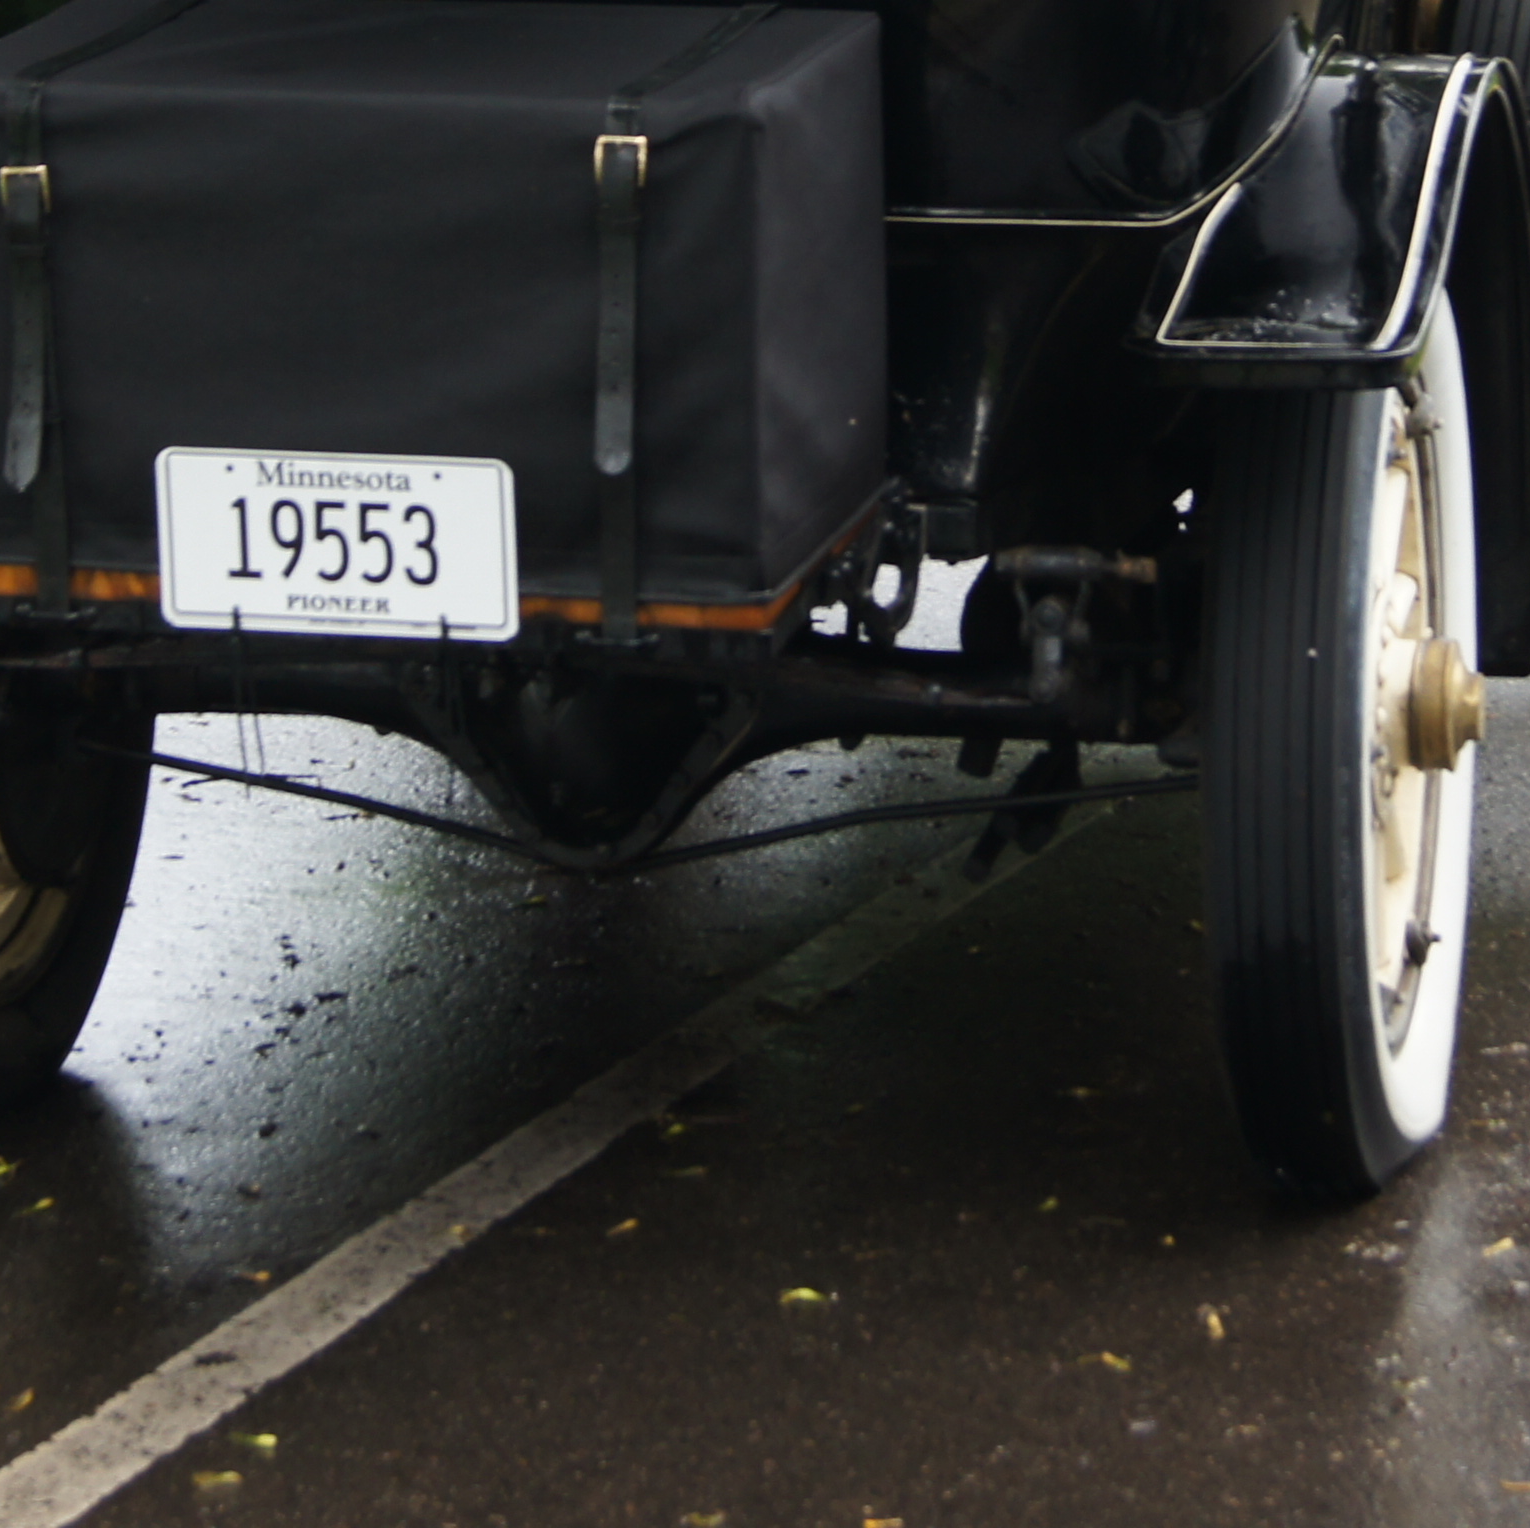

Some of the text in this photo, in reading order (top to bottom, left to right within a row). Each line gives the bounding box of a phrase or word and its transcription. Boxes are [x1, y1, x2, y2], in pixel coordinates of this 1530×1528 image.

[255, 460, 412, 492] Minnesota
[228, 497, 440, 586] 19553
[286, 594, 391, 614] PIONEER
